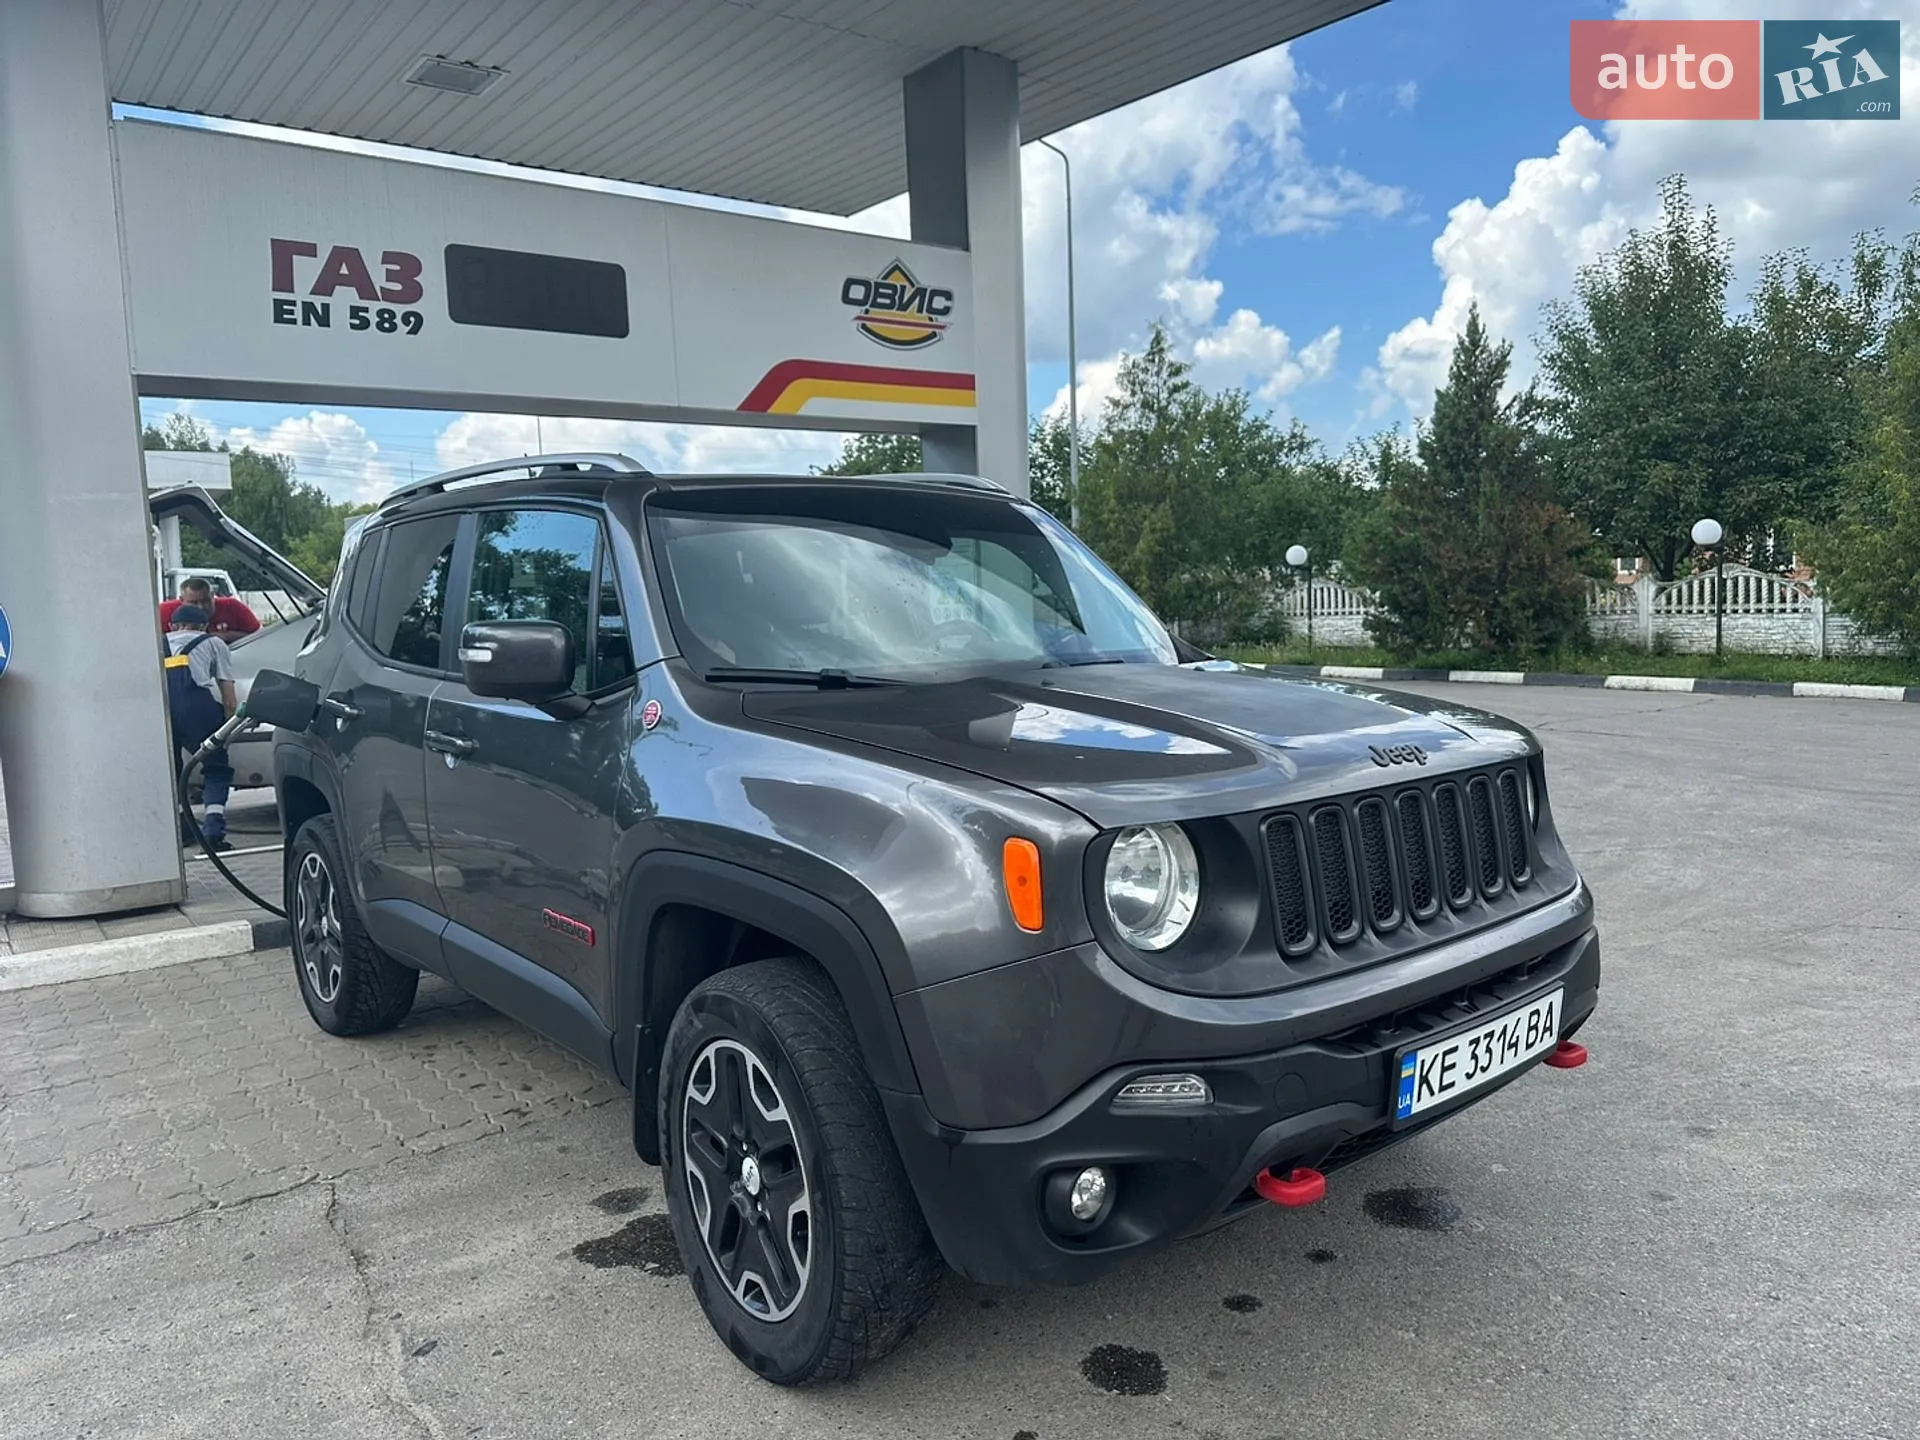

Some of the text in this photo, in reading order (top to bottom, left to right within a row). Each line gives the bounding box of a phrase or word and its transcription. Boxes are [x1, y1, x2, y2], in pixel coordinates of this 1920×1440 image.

[270, 238, 424, 305] ГАЗ
[841, 277, 953, 316] ОВИС
[273, 299, 424, 336] EN 589
[1368, 745, 1428, 767] Jeep
[1416, 1001, 1554, 1102] KE 3314 BA
[1398, 1093, 1411, 1109] UA
